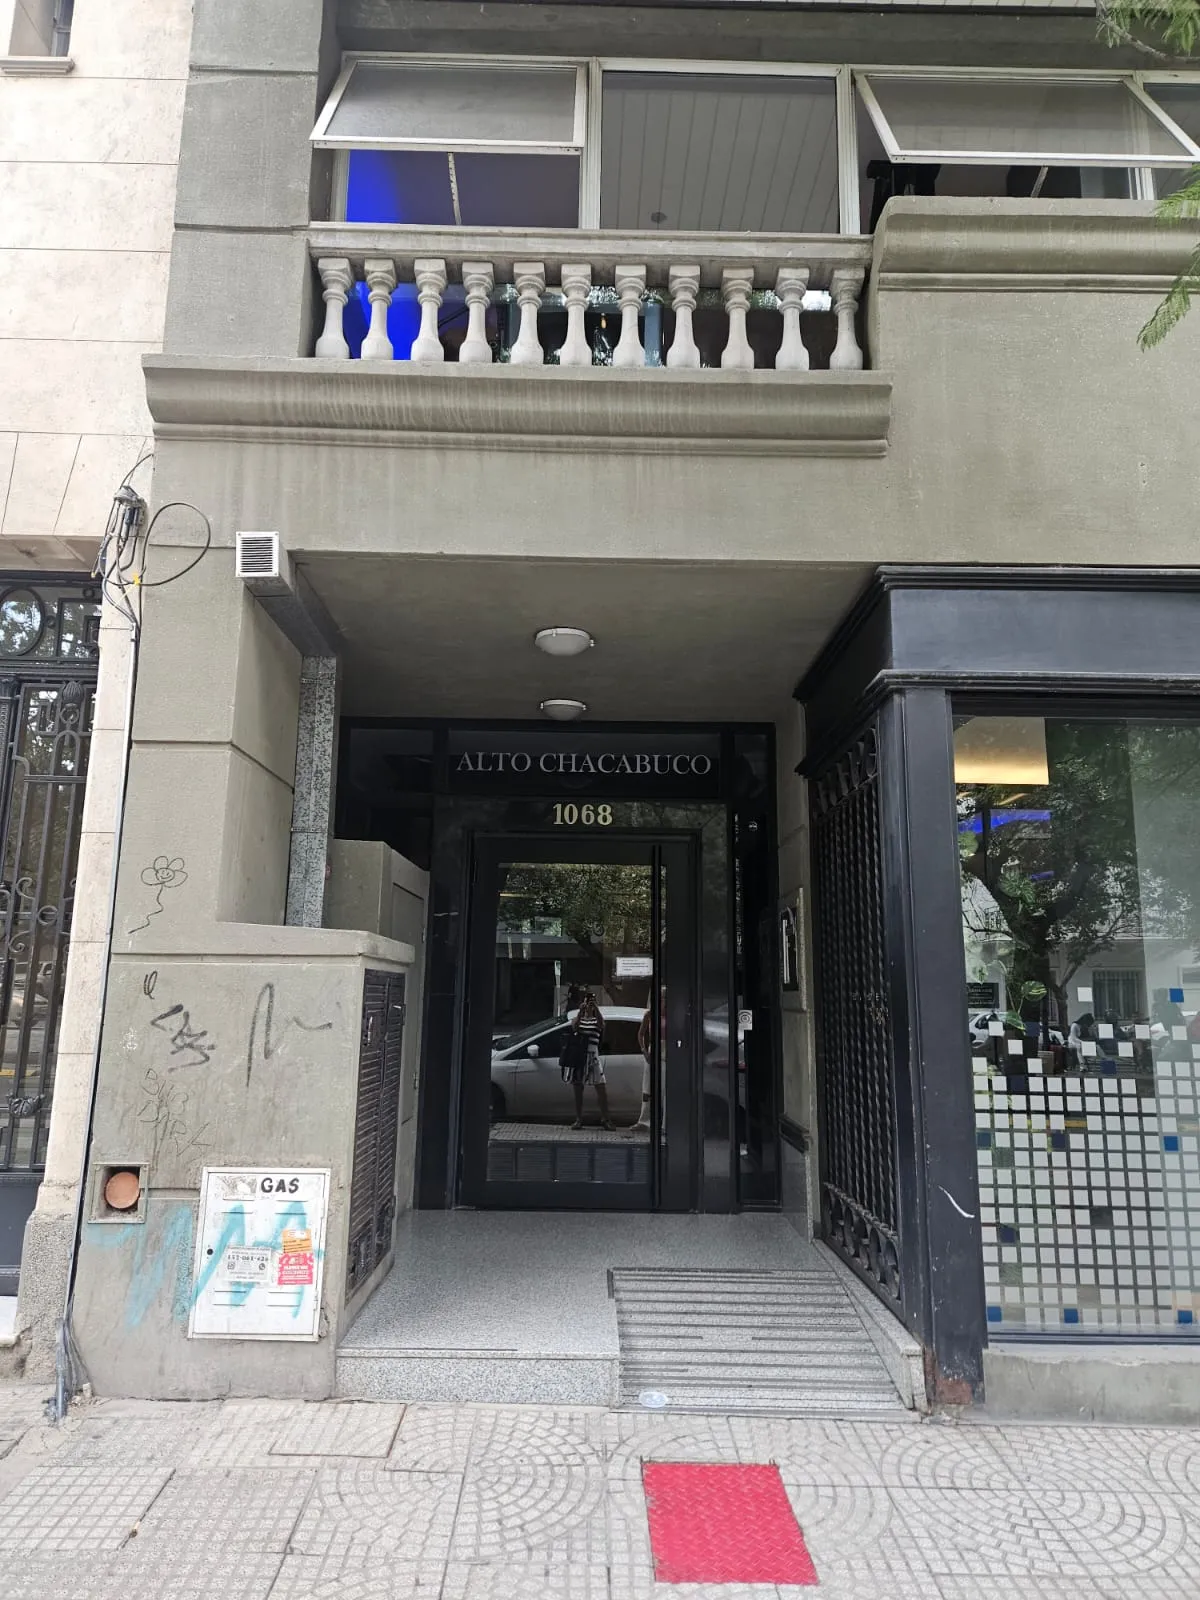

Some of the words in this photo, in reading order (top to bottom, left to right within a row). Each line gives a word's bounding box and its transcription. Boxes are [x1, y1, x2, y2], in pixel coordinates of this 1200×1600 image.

[456, 752, 531, 772] ALTO
[539, 753, 711, 774] CHACABUCO
[552, 803, 613, 825] 1068
[260, 1177, 299, 1193] GAS
